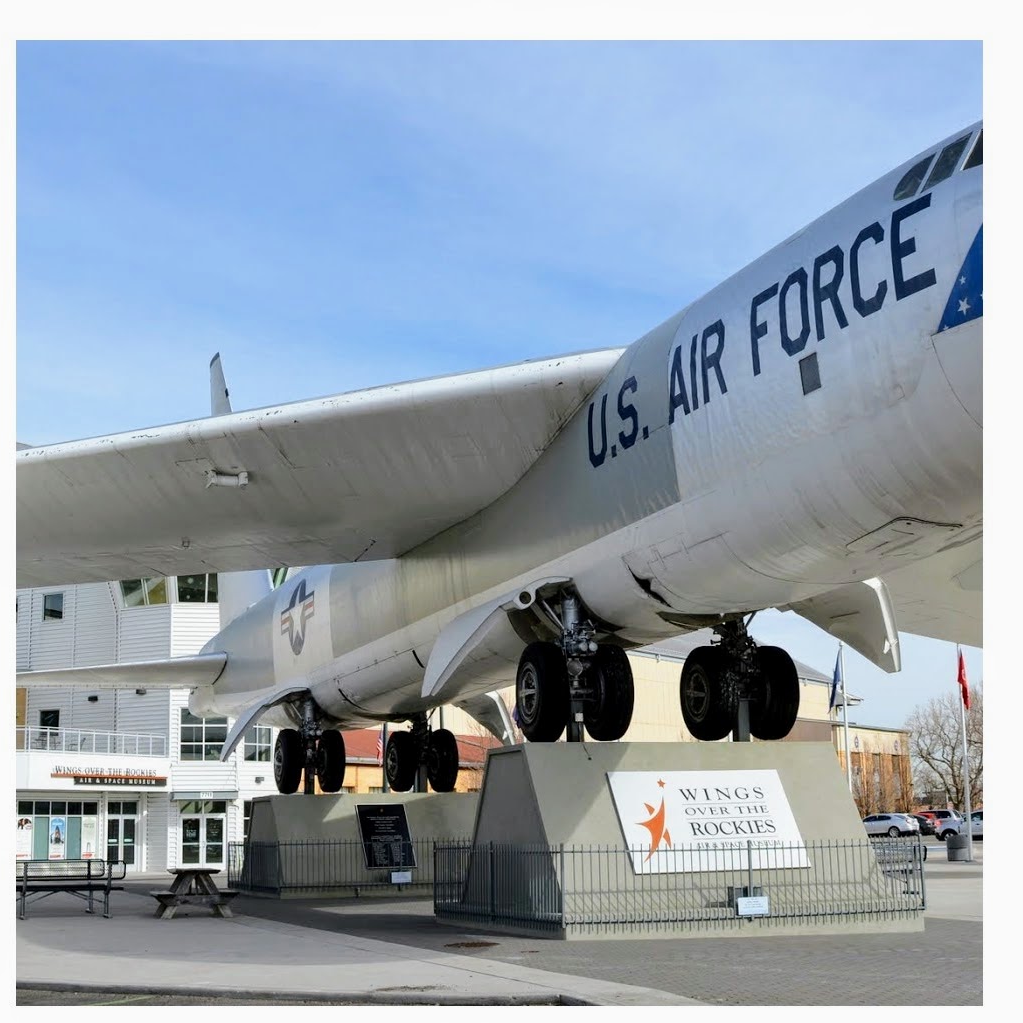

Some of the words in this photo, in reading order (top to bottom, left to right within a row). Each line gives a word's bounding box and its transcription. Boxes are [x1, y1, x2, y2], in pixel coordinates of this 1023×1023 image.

[587, 375, 649, 468] U.S.
[668, 319, 728, 426] AIR
[750, 192, 937, 377] FORCE
[85, 767, 105, 775] OVER
[107, 768, 123, 776] THE
[125, 768, 157, 777] ROCKIES
[678, 786, 765, 801] WINGS
[684, 806, 731, 816] OVER
[734, 804, 770, 815] THE
[689, 819, 777, 836] ROCKIES
